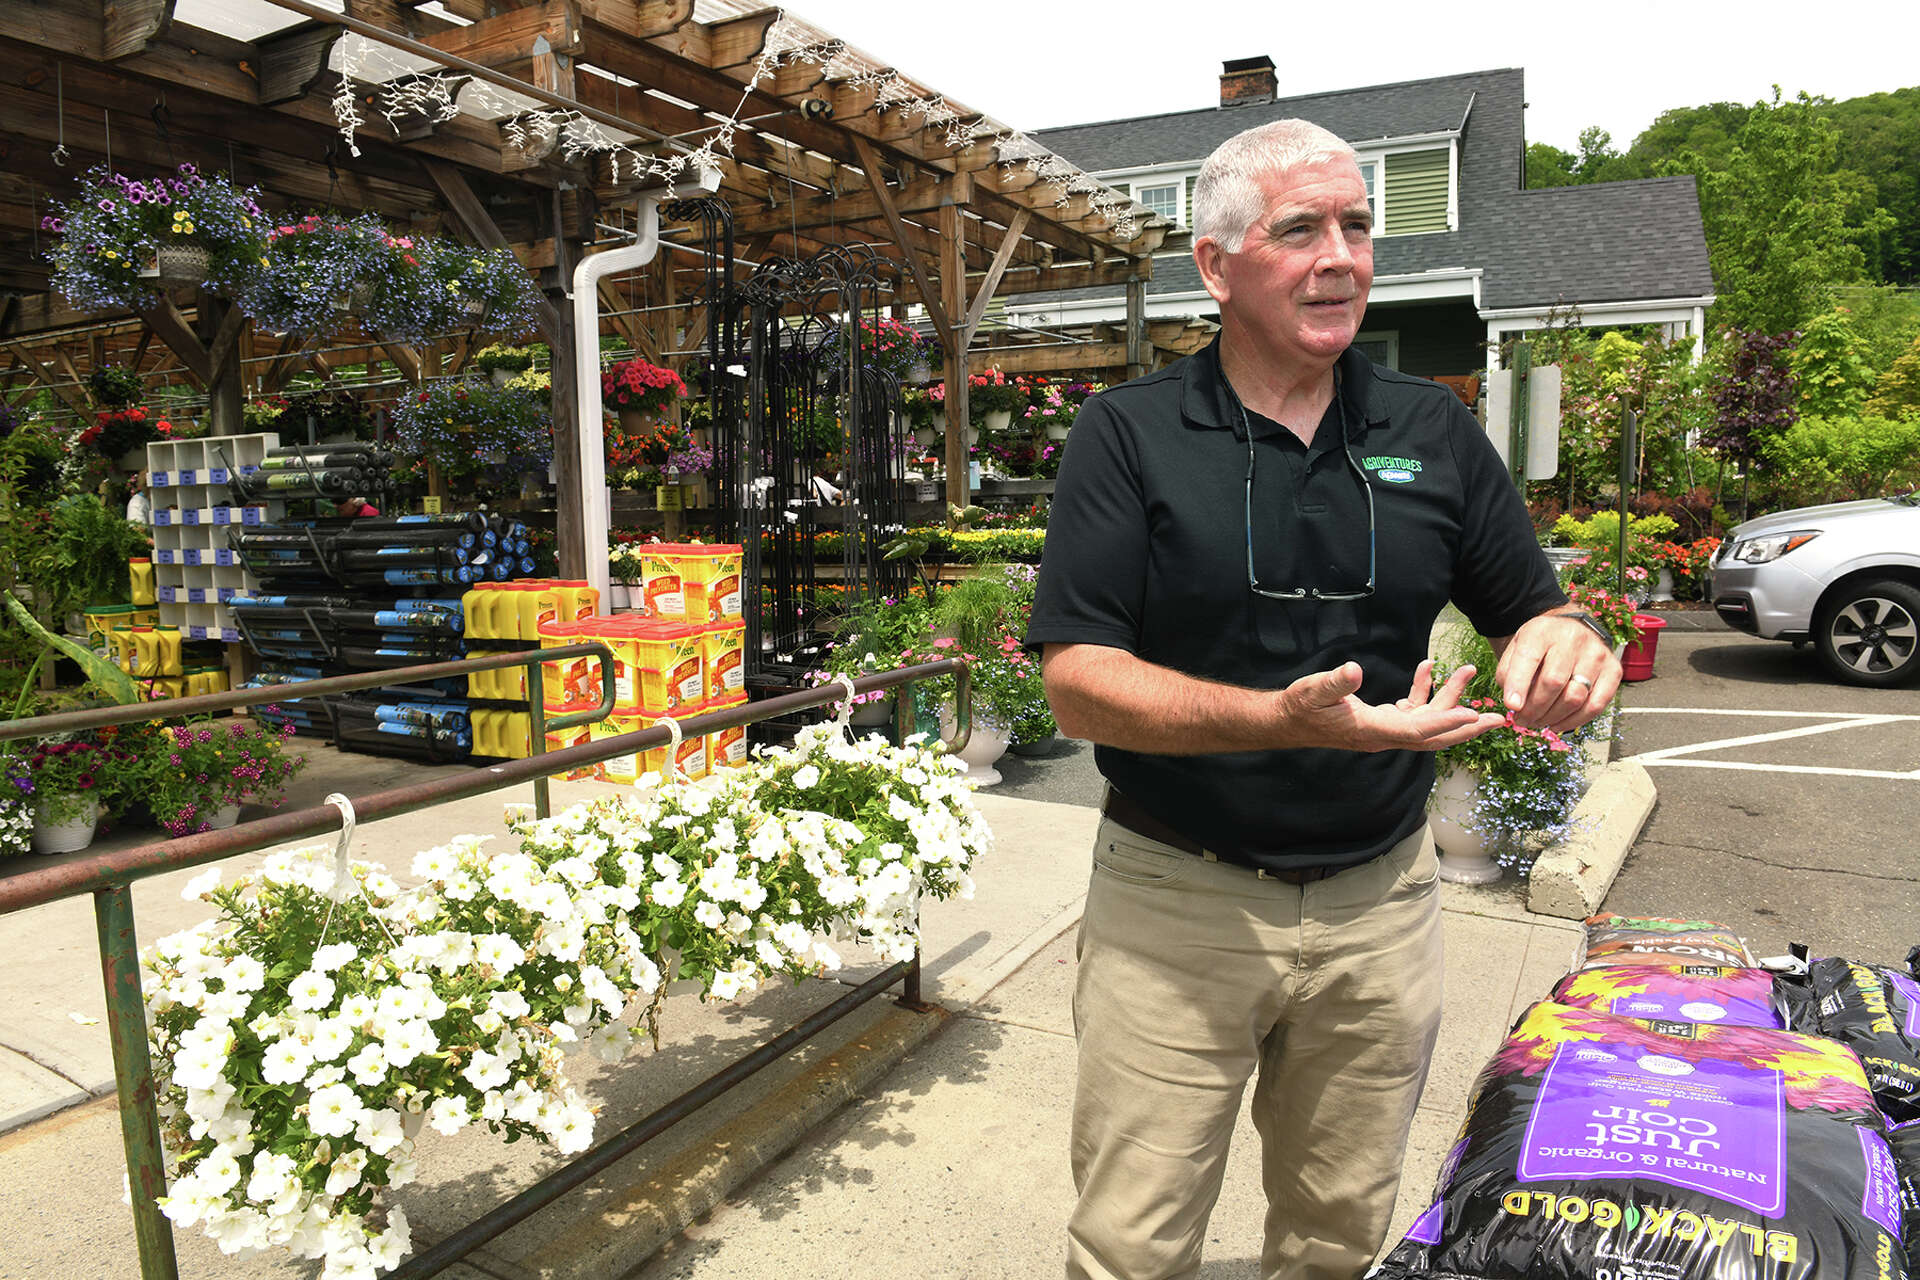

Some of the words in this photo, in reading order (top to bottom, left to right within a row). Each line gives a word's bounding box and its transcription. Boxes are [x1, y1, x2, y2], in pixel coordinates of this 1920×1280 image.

[1592, 1105, 1718, 1137] Coir
[1538, 1146, 1634, 1163] Organic
[1585, 1122, 1721, 1158] Just
[1640, 1153, 1658, 1165] &
[1665, 1155, 1768, 1185] Natural
[1500, 1189, 1623, 1228] GOLD
[1641, 1203, 1799, 1264] BLACK
